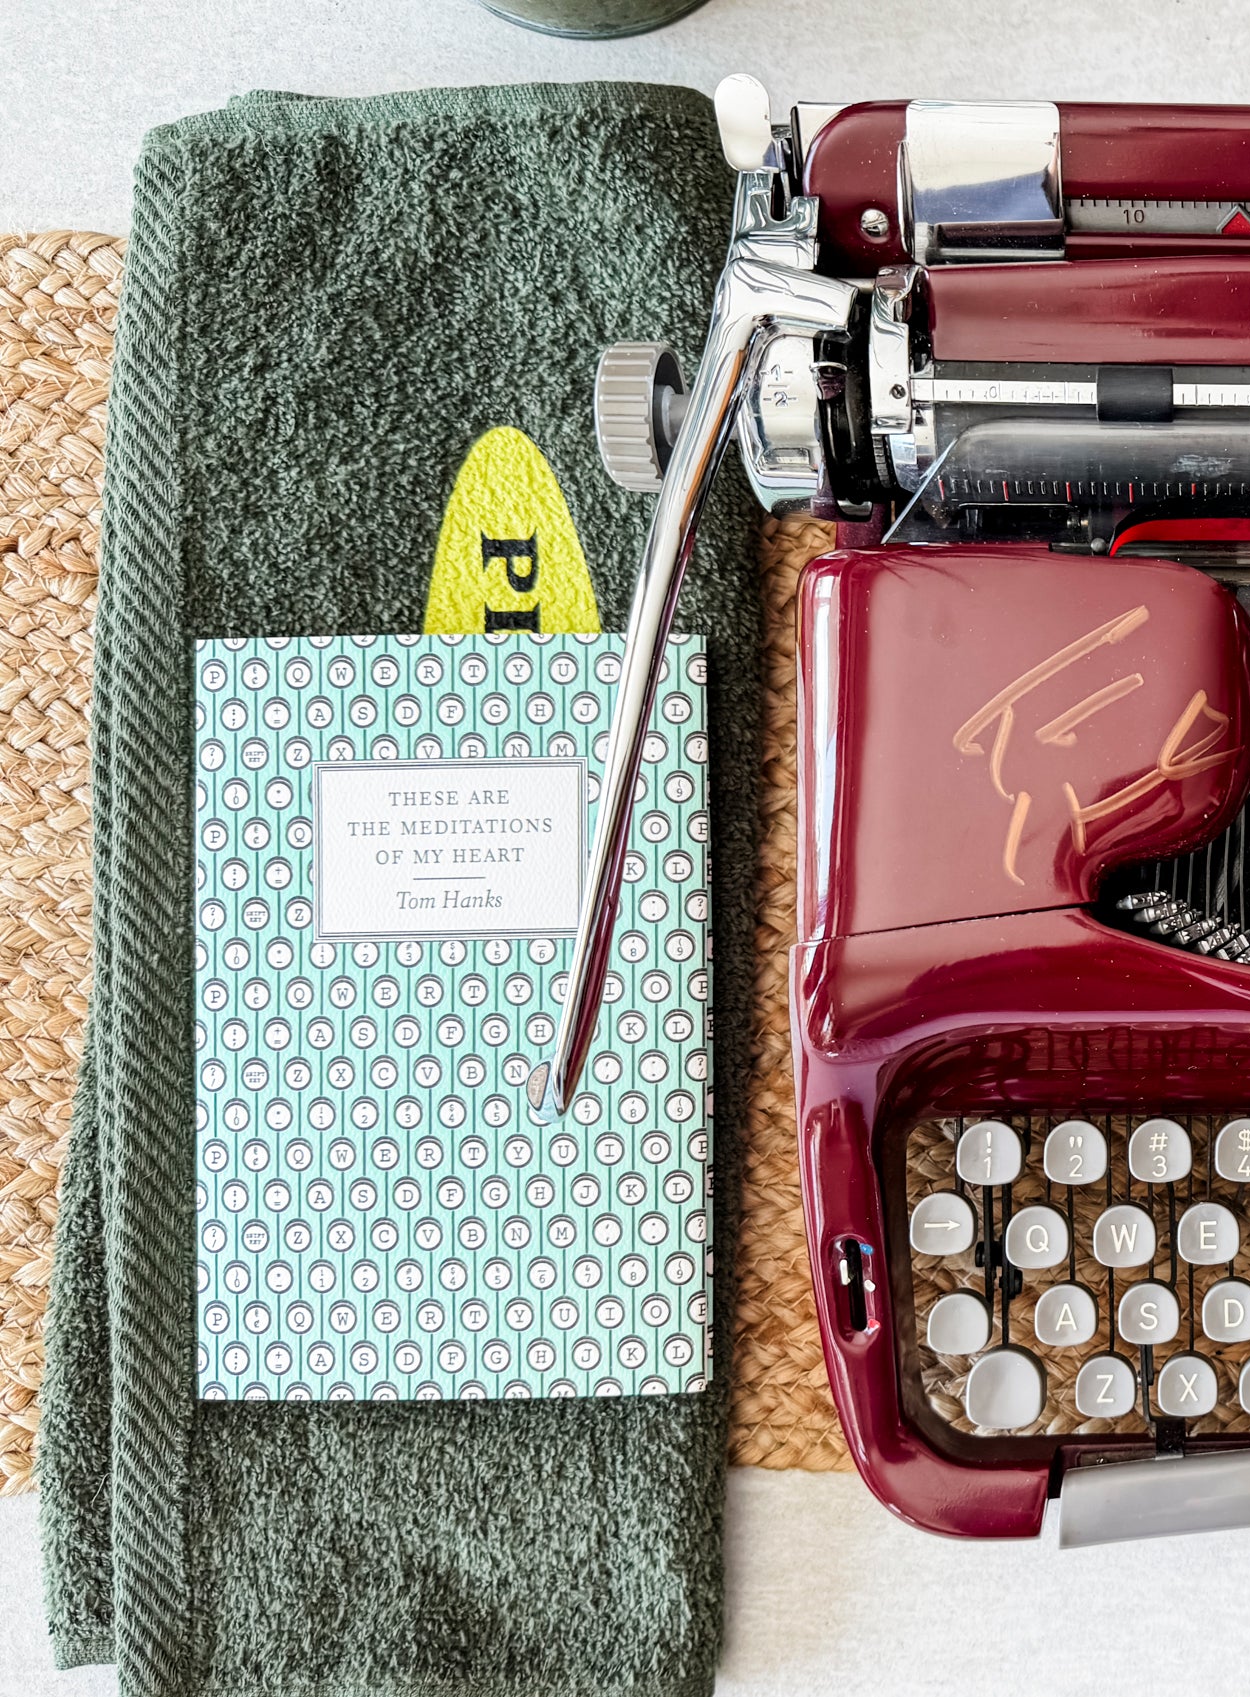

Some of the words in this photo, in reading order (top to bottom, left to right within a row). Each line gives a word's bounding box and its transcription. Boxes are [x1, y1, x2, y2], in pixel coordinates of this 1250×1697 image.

[1123, 208, 1145, 224] 10
[210, 671, 220, 684] P
[293, 668, 303, 682] Q
[335, 668, 347, 680] W
[380, 667, 390, 679] E
[424, 666, 435, 678] R
[469, 665, 479, 677] T
[513, 664, 524, 677] Y
[558, 664, 570, 677] U
[604, 664, 614, 676] I
[314, 708, 325, 721] A
[358, 707, 368, 720] S
[402, 706, 413, 719] D
[446, 706, 457, 718] F
[489, 704, 501, 717] G
[534, 704, 546, 717] H
[580, 703, 591, 716] J
[671, 704, 683, 716] L
[388, 791, 459, 806] THESE
[468, 790, 510, 805] ARE
[347, 821, 391, 837] THE
[401, 818, 553, 836] MEDITATIONS
[650, 822, 662, 834] O
[375, 849, 404, 865] OF
[413, 849, 444, 864] MY
[453, 847, 525, 863] HEART
[626, 861, 638, 876] K
[672, 862, 684, 875] L
[396, 891, 436, 910] Tom
[442, 889, 503, 909] Hanks
[212, 1151, 222, 1164] P
[293, 1149, 304, 1164] Q
[336, 1150, 348, 1162] W
[380, 1149, 391, 1162] E
[424, 1148, 435, 1161] R
[469, 1147, 479, 1160] T
[513, 1147, 524, 1160] Y
[558, 1145, 569, 1158] U
[605, 1144, 614, 1157] I
[650, 1142, 662, 1155] O
[984, 1157, 990, 1178] 1
[1070, 1155, 1082, 1177] 2
[1153, 1156, 1166, 1177] 3
[314, 1191, 326, 1203] A
[358, 1190, 368, 1203] S
[402, 1190, 413, 1202] D
[447, 1189, 457, 1202] F
[489, 1188, 500, 1201] G
[534, 1187, 545, 1200] H
[580, 1185, 591, 1199] J
[626, 1184, 637, 1197] K
[673, 1183, 684, 1196] L
[294, 1231, 302, 1244] Z
[336, 1231, 346, 1244] X
[379, 1230, 389, 1243] C
[422, 1229, 434, 1242] V
[467, 1229, 478, 1242] B
[511, 1228, 522, 1241] N
[556, 1227, 568, 1240] M
[1026, 1225, 1049, 1252] Q
[1111, 1224, 1137, 1252] W
[1200, 1221, 1217, 1249] E
[234, 1278, 240, 1288] 0
[320, 1278, 325, 1288] 1
[363, 1278, 369, 1287] 2
[406, 1277, 412, 1286] 3
[450, 1276, 456, 1286] 4
[495, 1276, 501, 1285] 5
[539, 1274, 545, 1284] 6
[585, 1274, 591, 1283] 7
[630, 1272, 637, 1281] 8
[676, 1270, 683, 1280] 9
[1056, 1303, 1077, 1331] A
[1140, 1303, 1157, 1330] S
[1225, 1299, 1244, 1327] D
[1097, 1375, 1113, 1403] Z
[1180, 1374, 1198, 1401] X
